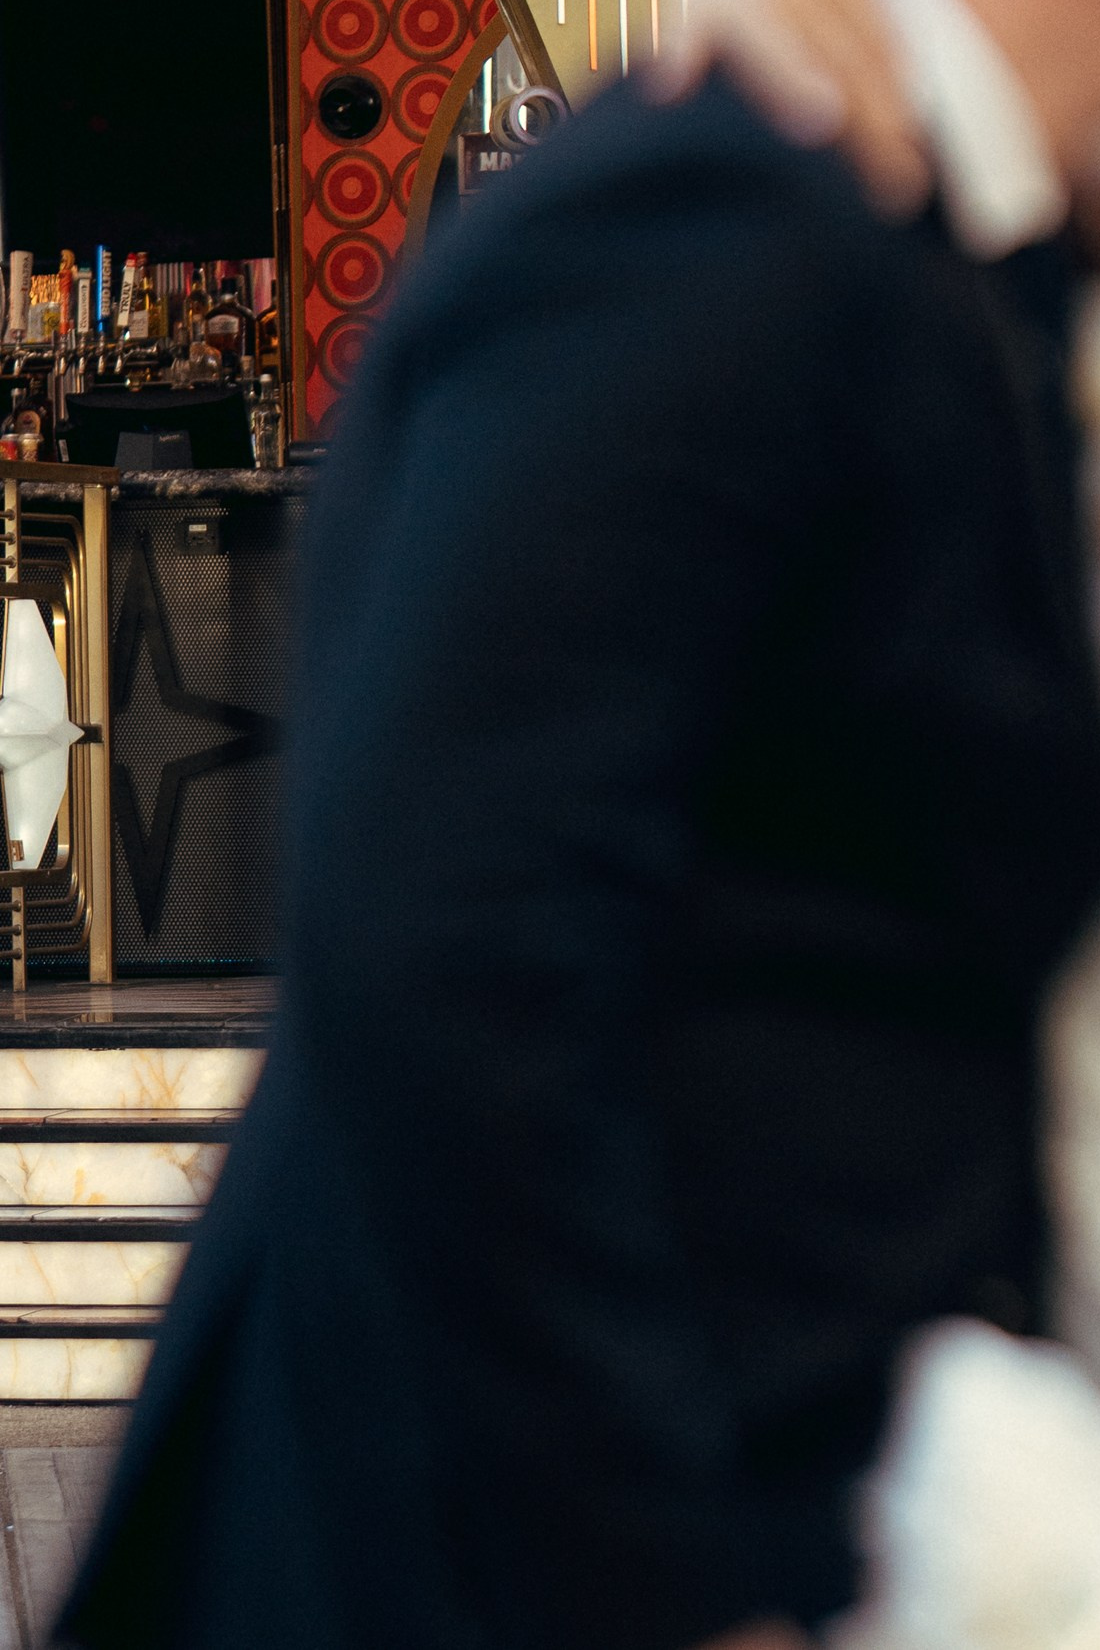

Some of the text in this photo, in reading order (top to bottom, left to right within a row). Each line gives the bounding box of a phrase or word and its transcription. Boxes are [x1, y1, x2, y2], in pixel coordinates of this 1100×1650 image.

[22, 256, 31, 287] ULTRA
[101, 251, 111, 317] BUD LIGHT
[119, 281, 132, 313] TRULY
